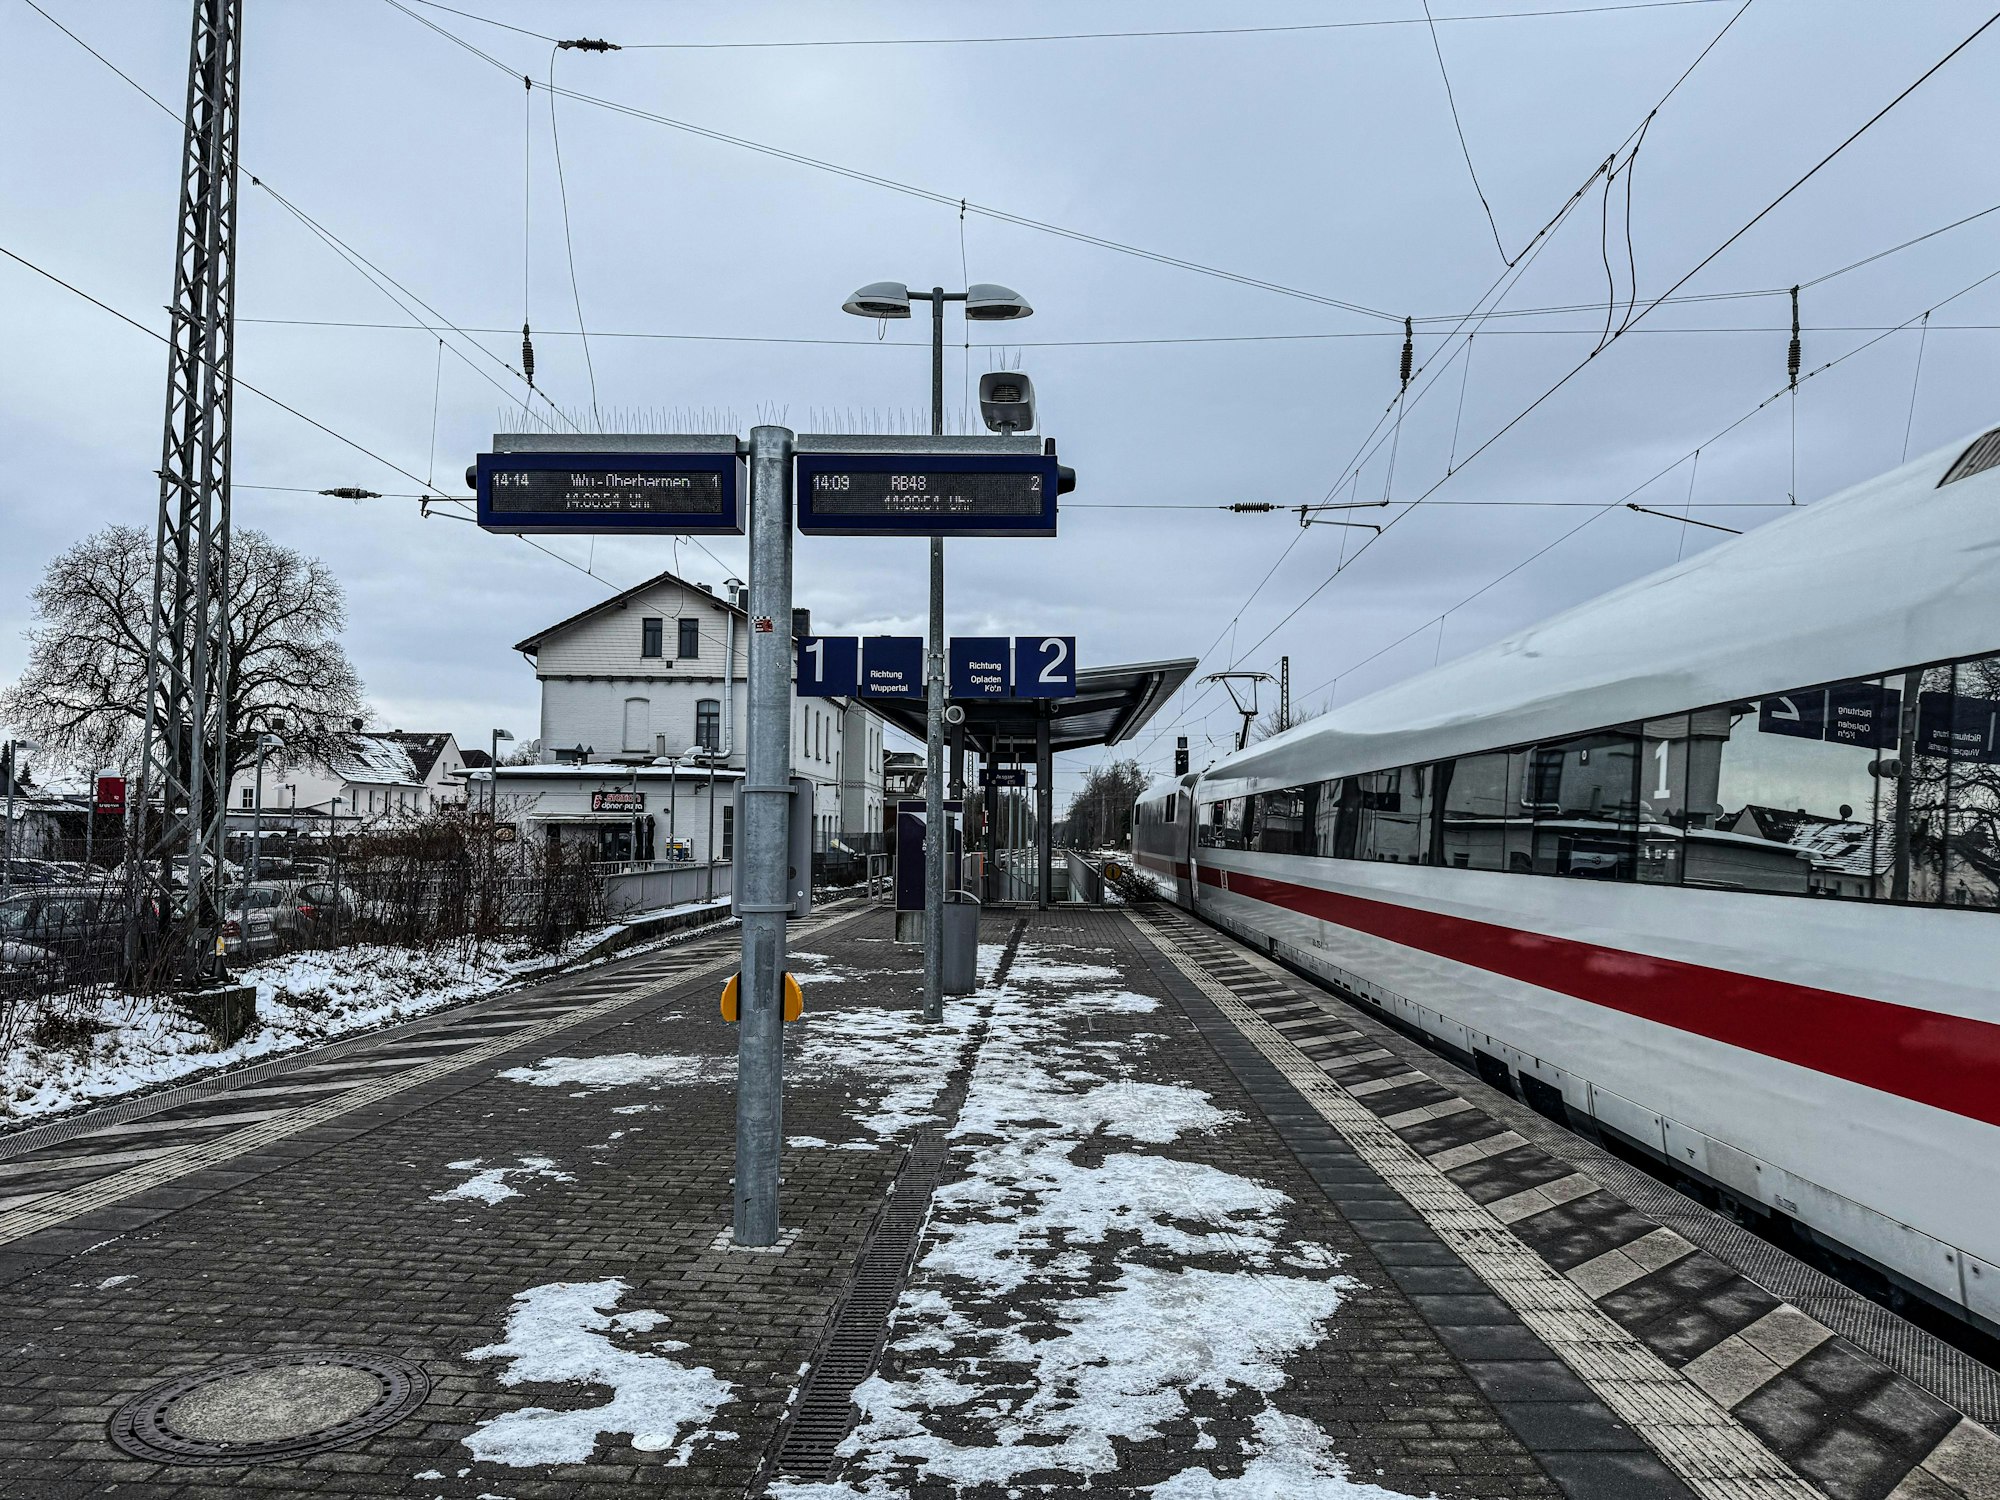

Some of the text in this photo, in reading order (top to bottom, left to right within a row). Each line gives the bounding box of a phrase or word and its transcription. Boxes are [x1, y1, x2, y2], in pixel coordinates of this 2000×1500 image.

[493, 473, 530, 488] 14:14
[711, 473, 719, 488] 1
[813, 475, 1040, 491] 14:09 RB48 2
[805, 638, 824, 682] 1
[969, 661, 1002, 672] Richtung
[1038, 637, 1068, 683] 2
[870, 669, 903, 680] Richtung
[971, 675, 1002, 684] Opladen
[870, 683, 909, 693] Wuppertal
[1653, 740, 1671, 800] 1
